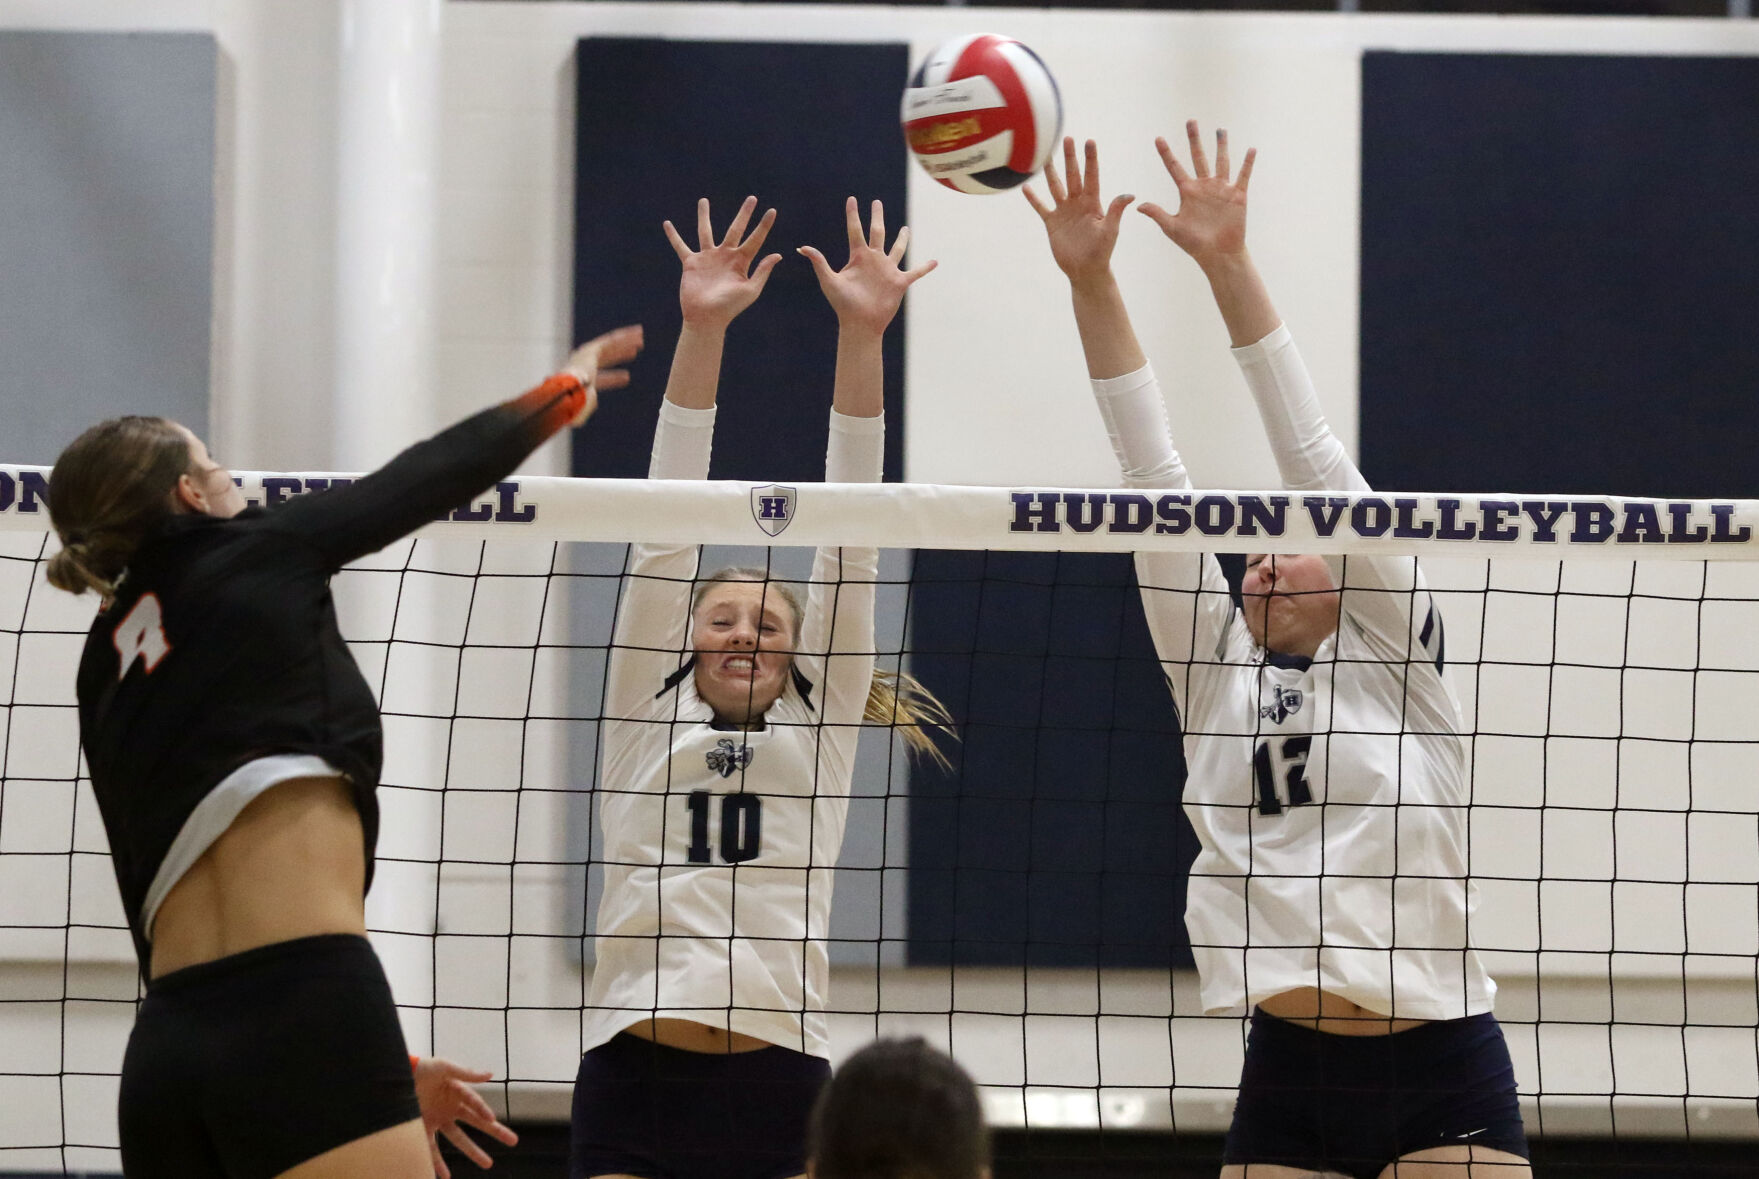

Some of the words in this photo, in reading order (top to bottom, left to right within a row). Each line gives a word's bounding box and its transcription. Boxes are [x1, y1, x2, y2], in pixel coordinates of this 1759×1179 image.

[759, 496, 789, 520] H
[1009, 491, 1291, 537] HUDSON
[1301, 496, 1753, 544] VOLLEYBALL
[1254, 735, 1314, 817] 12
[685, 789, 763, 865] 10
